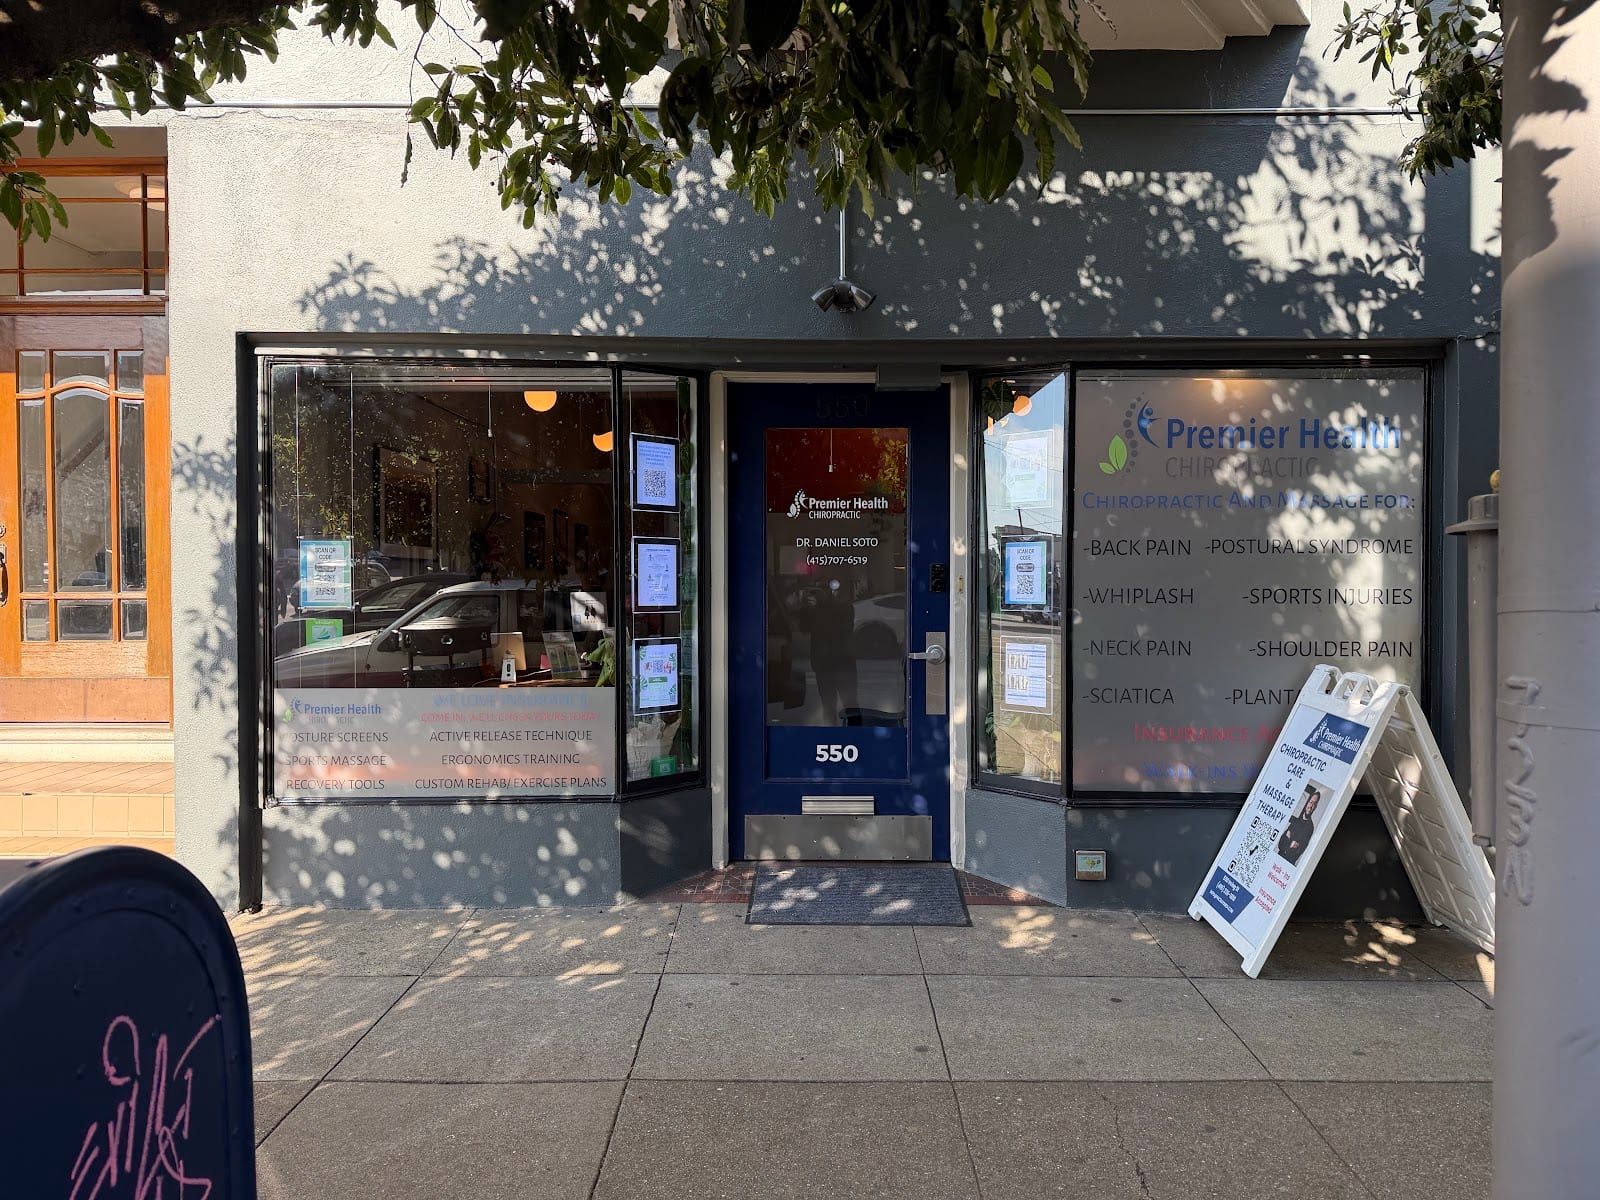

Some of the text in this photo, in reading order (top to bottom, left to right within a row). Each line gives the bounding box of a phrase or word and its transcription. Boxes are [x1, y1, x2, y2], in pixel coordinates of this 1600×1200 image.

[1167, 417, 1400, 449] Premier Health
[809, 497, 888, 509] Premier Health
[809, 511, 860, 519] CHIROPRACTIC
[796, 538, 878, 547] DR. DANIEL SOTO
[1083, 540, 1191, 555] -BACK PAIN
[1204, 539, 1413, 554] -POSTURAL SYNDROME
[806, 555, 868, 565] (415)707-6519
[1083, 588, 1193, 604] -WHIPLASH
[1242, 588, 1412, 605] -SPORTS INJURIES
[1083, 640, 1191, 656] -NECK PAIN
[1249, 641, 1412, 657] -SHOULDER PAIN
[1082, 688, 1174, 704] -SCIATICA
[304, 703, 381, 715] Premier Health
[338, 732, 388, 742] SCREENS
[430, 730, 592, 742] ACTIVE RELEASE TECHNIQUE
[1134, 724, 1249, 742] INSURANCE
[1323, 728, 1360, 752] Premier Health
[286, 755, 386, 766] SPORTS MASSAGE
[442, 754, 580, 765] ERGONOMICS TRAINING
[816, 744, 859, 762] 550
[1280, 743, 1327, 772] CHIROPRACTIC
[1287, 763, 1306, 779] CARE
[286, 780, 385, 790] RECOVERY TOOLS
[415, 778, 464, 789] CUSTOM
[514, 778, 567, 788] EXERCISE
[570, 777, 607, 787] PLANS
[1285, 779, 1292, 789] &
[1262, 784, 1295, 809] MASSAGE
[1256, 800, 1287, 823] THERAPY
